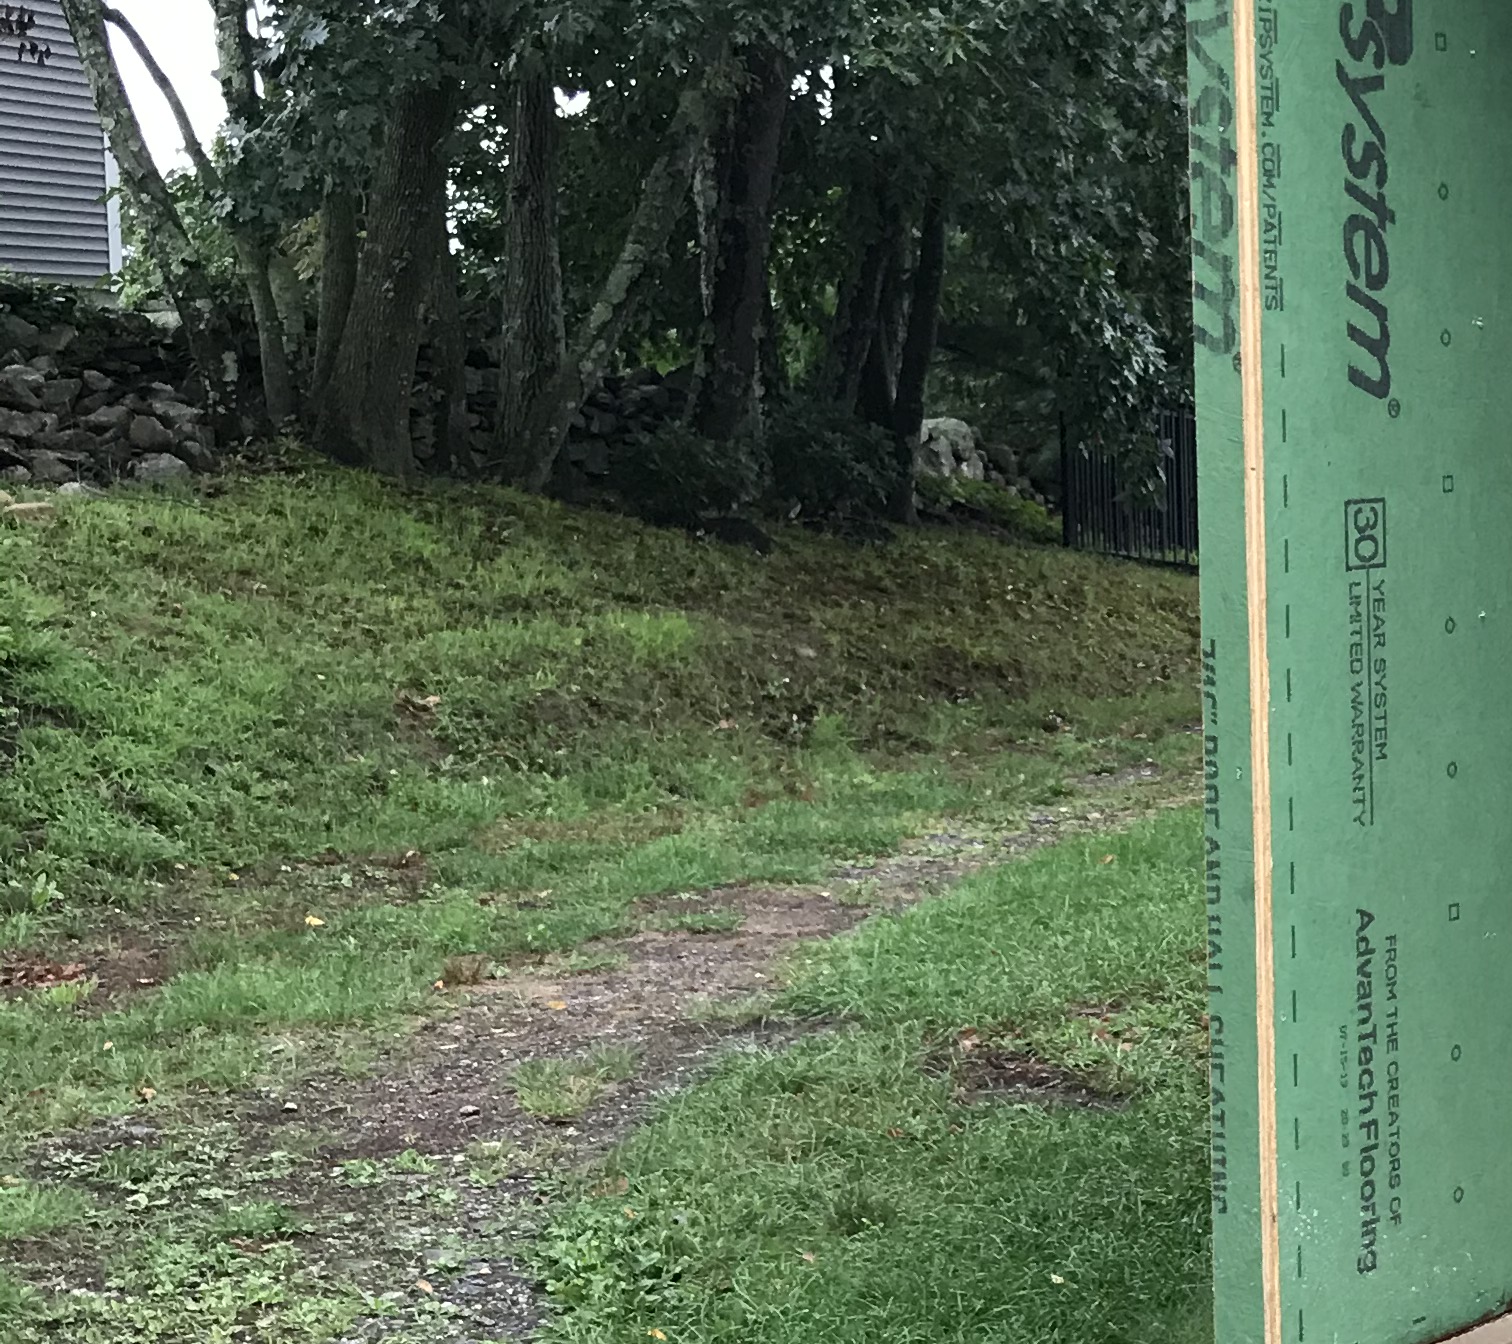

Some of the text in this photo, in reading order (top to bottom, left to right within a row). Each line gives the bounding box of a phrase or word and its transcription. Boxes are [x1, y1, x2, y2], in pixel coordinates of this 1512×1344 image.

[1353, 505, 1379, 563] 30
[1349, 581, 1367, 828] LIMITED WARRANTY
[1372, 578, 1389, 761] YEAR SYSTEM
[1385, 934, 1403, 1228] FROM THE CREATORS OF
